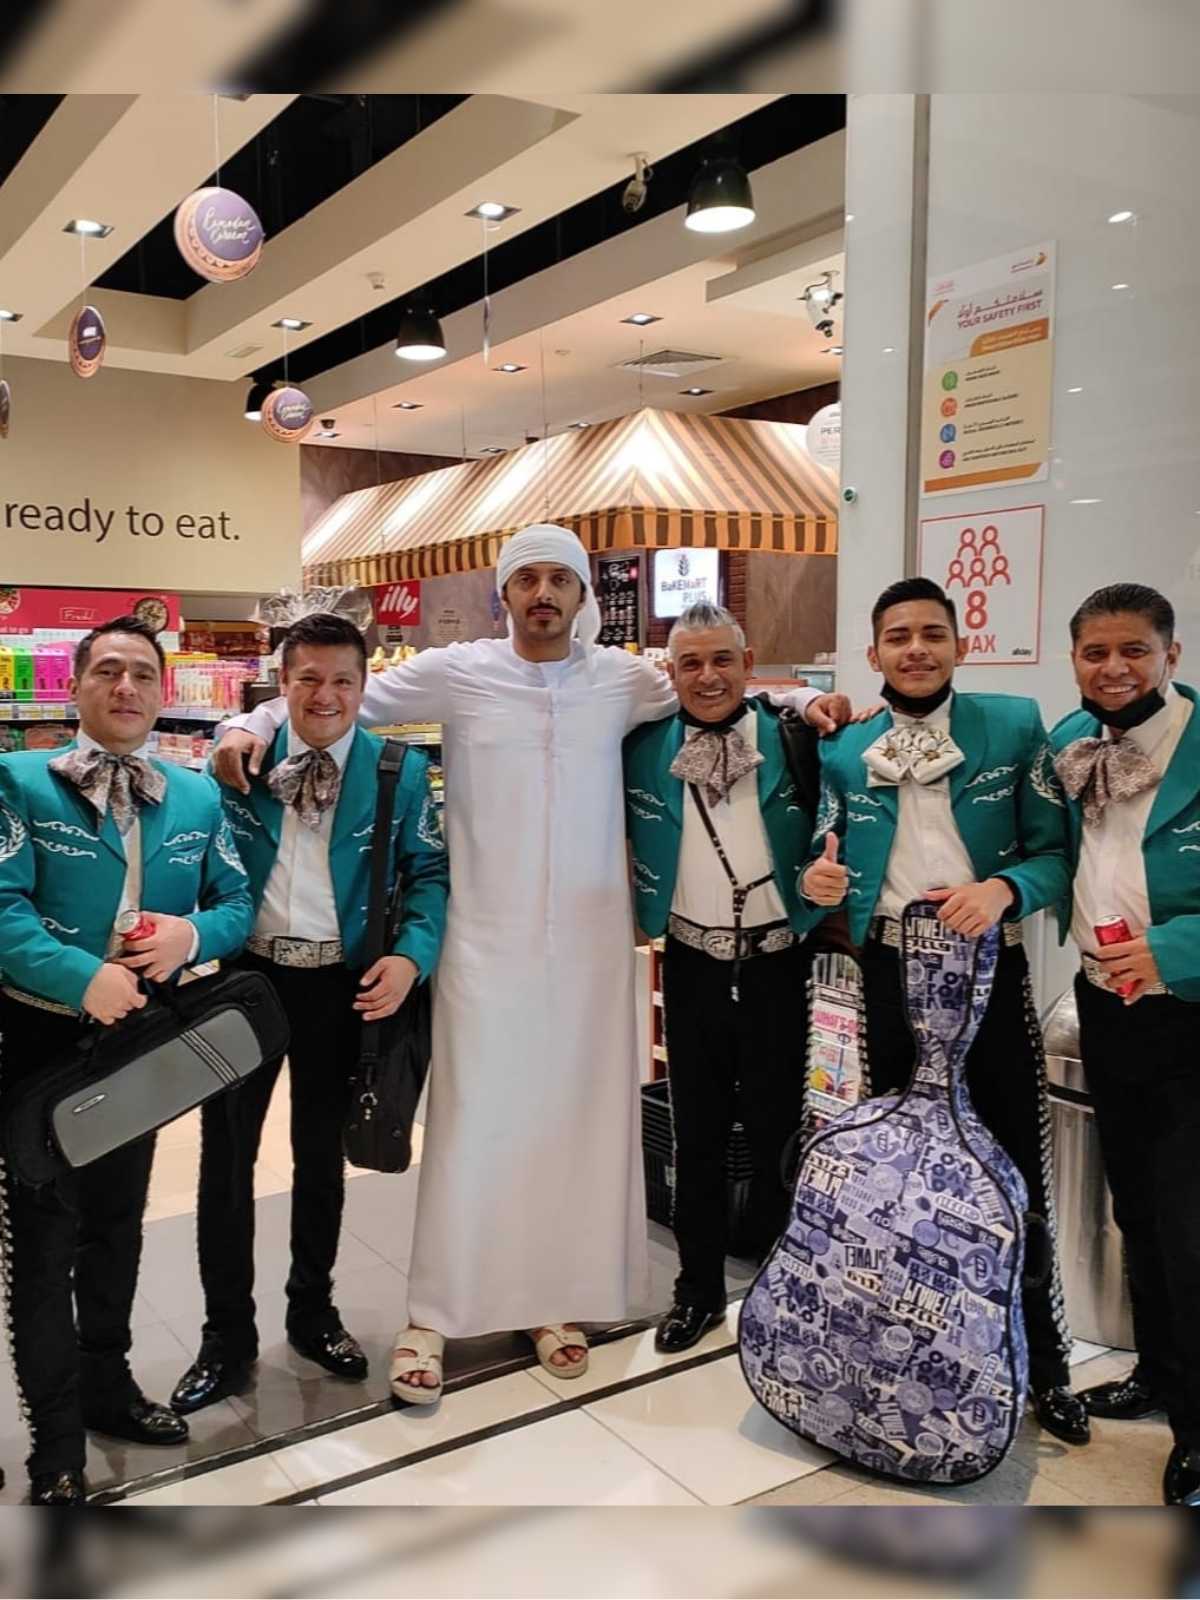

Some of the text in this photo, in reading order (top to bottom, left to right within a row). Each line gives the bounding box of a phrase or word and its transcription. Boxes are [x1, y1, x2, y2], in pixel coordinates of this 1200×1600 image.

[957, 299, 1043, 329] YOUR SAFETY FIRST
[5, 498, 240, 543] ready to eat.
[380, 586, 418, 619] illy
[965, 590, 987, 629] 8
